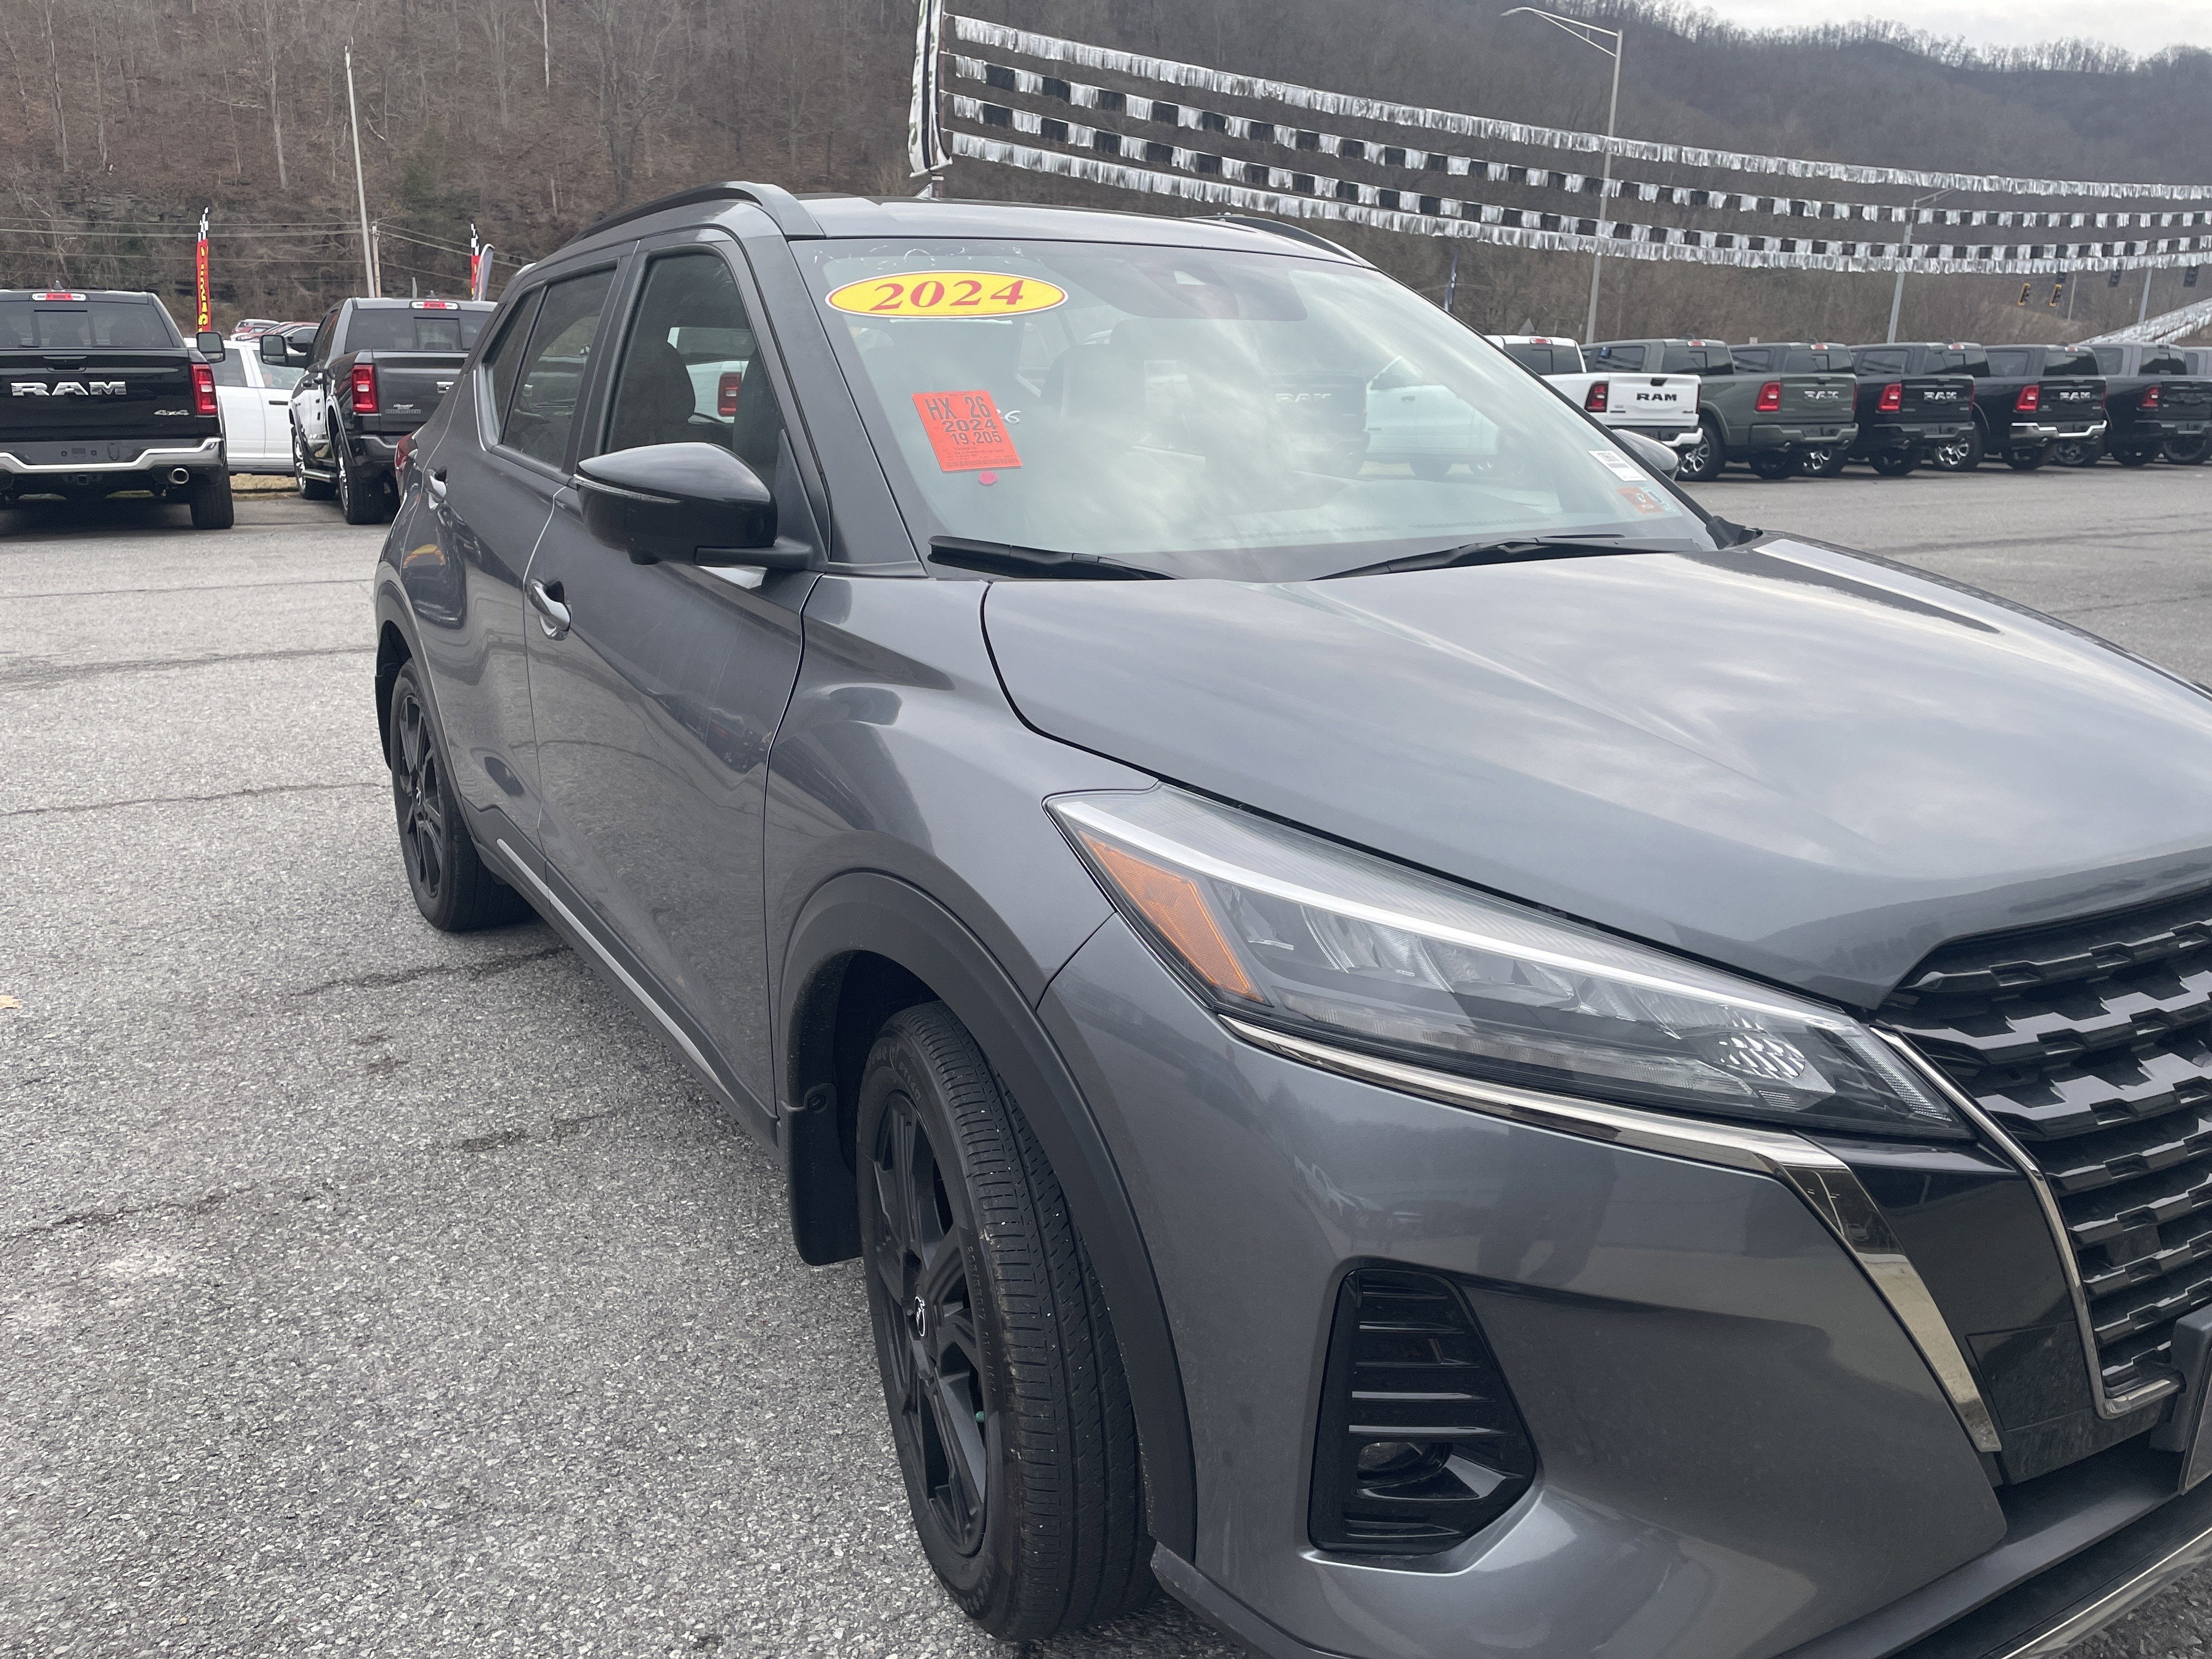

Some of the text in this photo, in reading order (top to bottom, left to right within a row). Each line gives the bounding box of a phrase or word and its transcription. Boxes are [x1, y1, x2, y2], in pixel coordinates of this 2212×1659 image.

[868, 280, 1024, 311] 2024
[10, 381, 127, 396] RAM
[1637, 393, 1677, 401] RAM
[924, 396, 991, 420] HX 26
[941, 419, 997, 432] 2024
[950, 431, 1002, 446] 19,205
